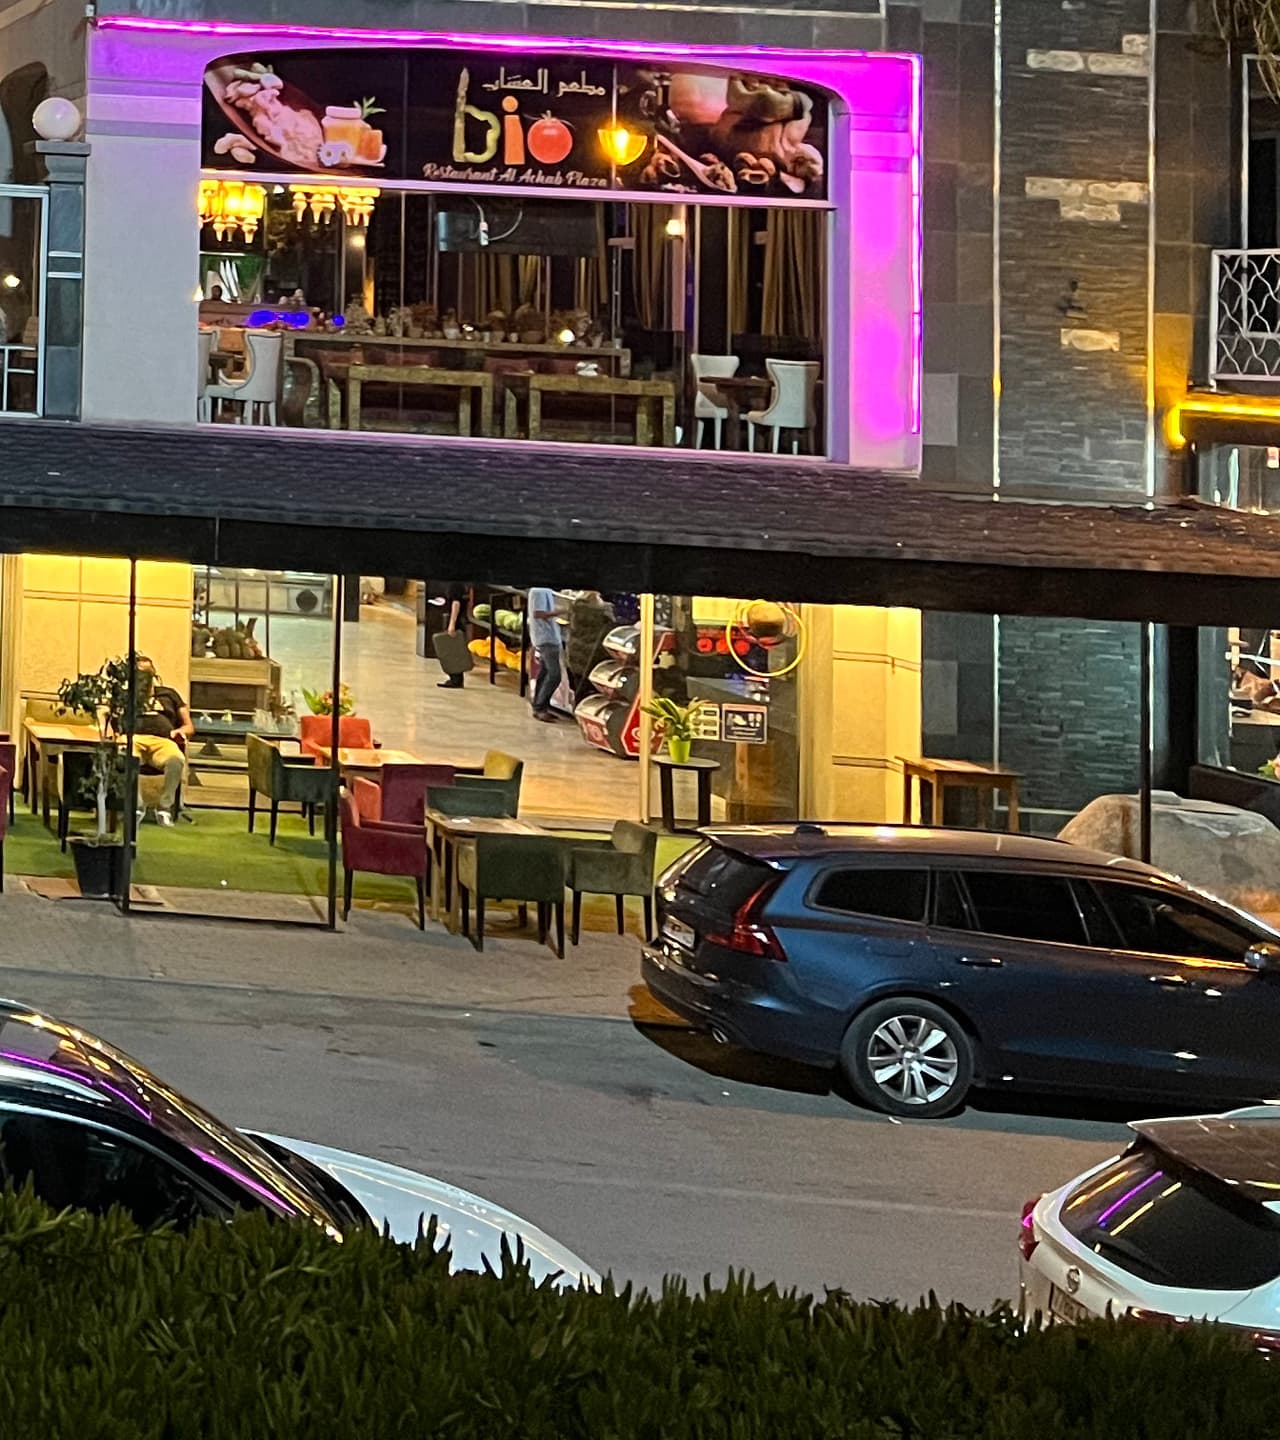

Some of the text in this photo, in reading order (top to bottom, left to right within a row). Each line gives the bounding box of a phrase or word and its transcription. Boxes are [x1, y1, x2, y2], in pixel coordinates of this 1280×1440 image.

[452, 66, 574, 165] bio
[421, 162, 608, 187] Restaurant Al Achab Plaza
